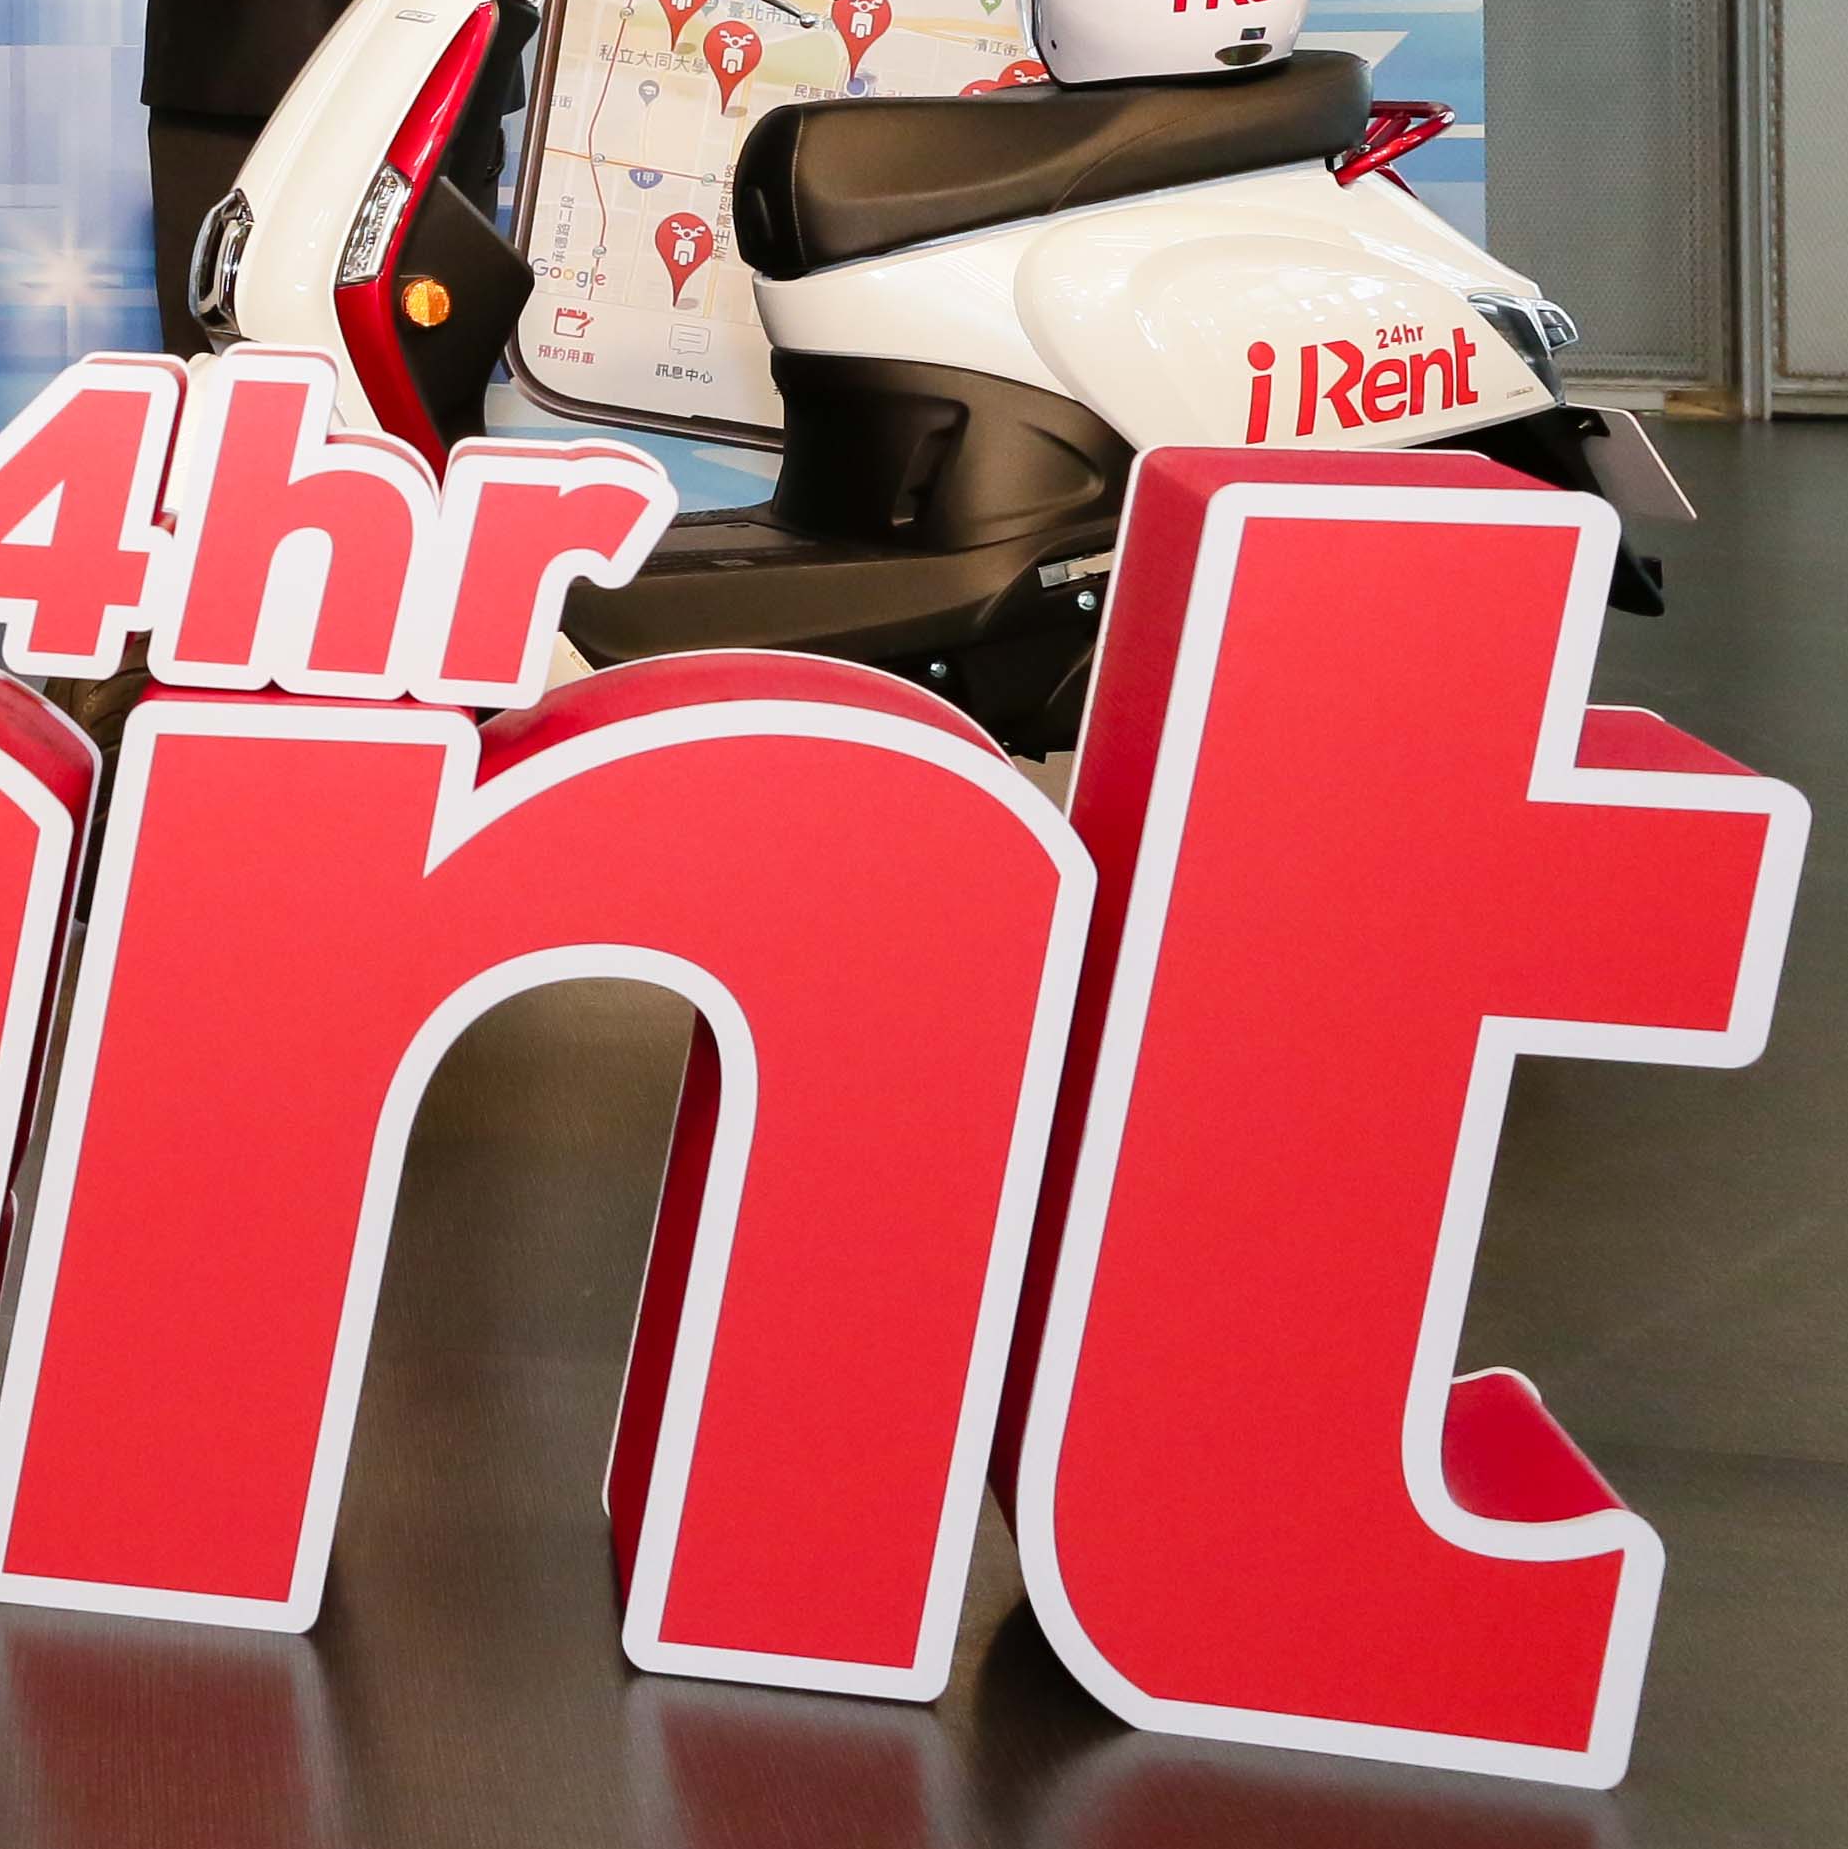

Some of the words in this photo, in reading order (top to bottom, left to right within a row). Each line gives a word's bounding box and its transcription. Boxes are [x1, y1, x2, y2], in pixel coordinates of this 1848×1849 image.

[531, 258, 607, 289] Google
[1375, 323, 1425, 351] 24hr
[537, 344, 595, 366] 預約用車
[655, 362, 714, 384] 訊息中心
[1245, 326, 1479, 445] iRent
